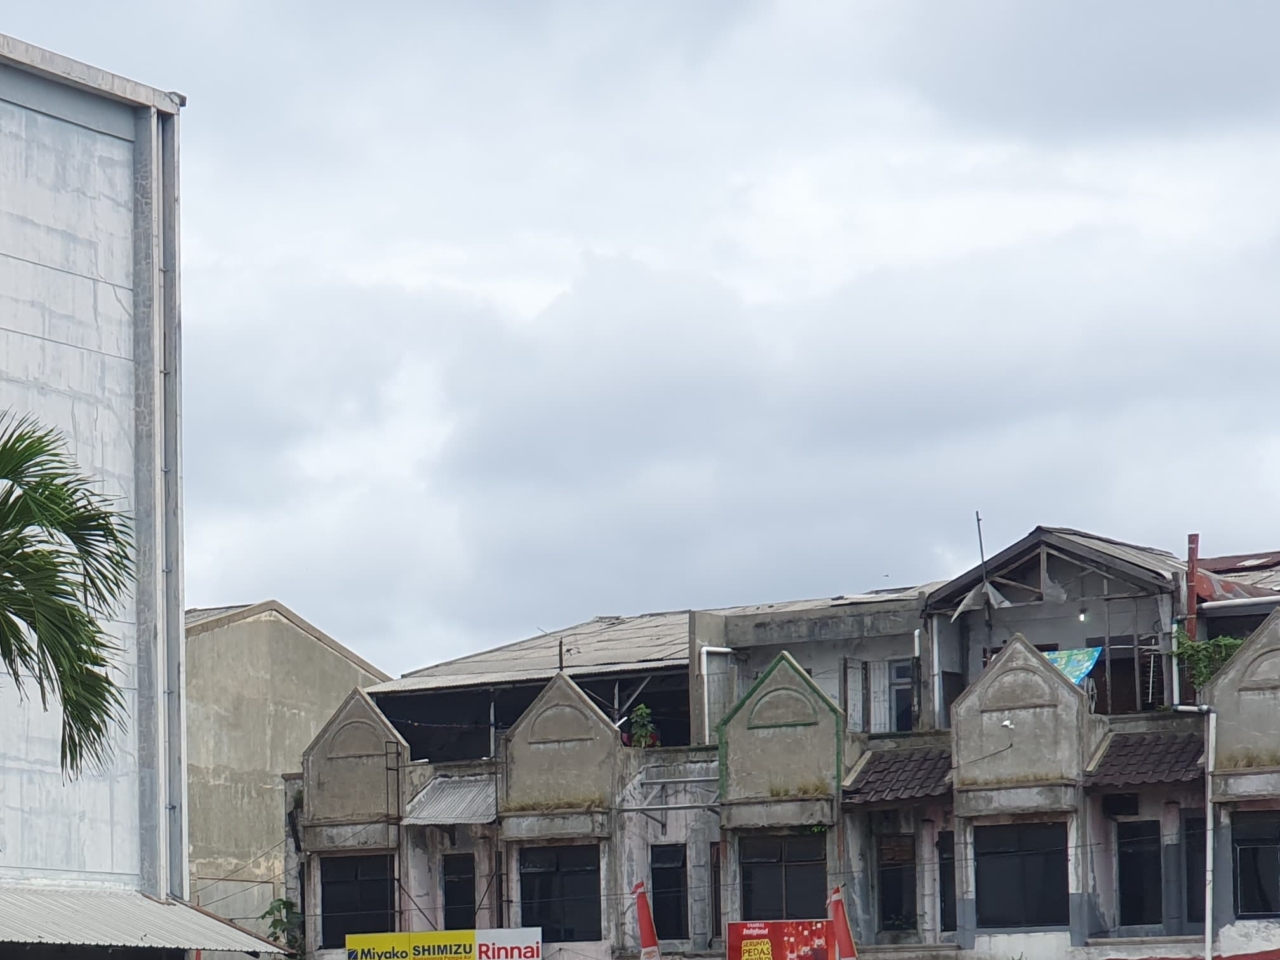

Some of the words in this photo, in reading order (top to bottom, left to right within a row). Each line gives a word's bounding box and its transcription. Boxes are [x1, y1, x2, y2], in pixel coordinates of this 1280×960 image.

[412, 943, 473, 956] SHIMIZU
[478, 941, 540, 960] Rinnai
[742, 947, 770, 957] PEDAS
